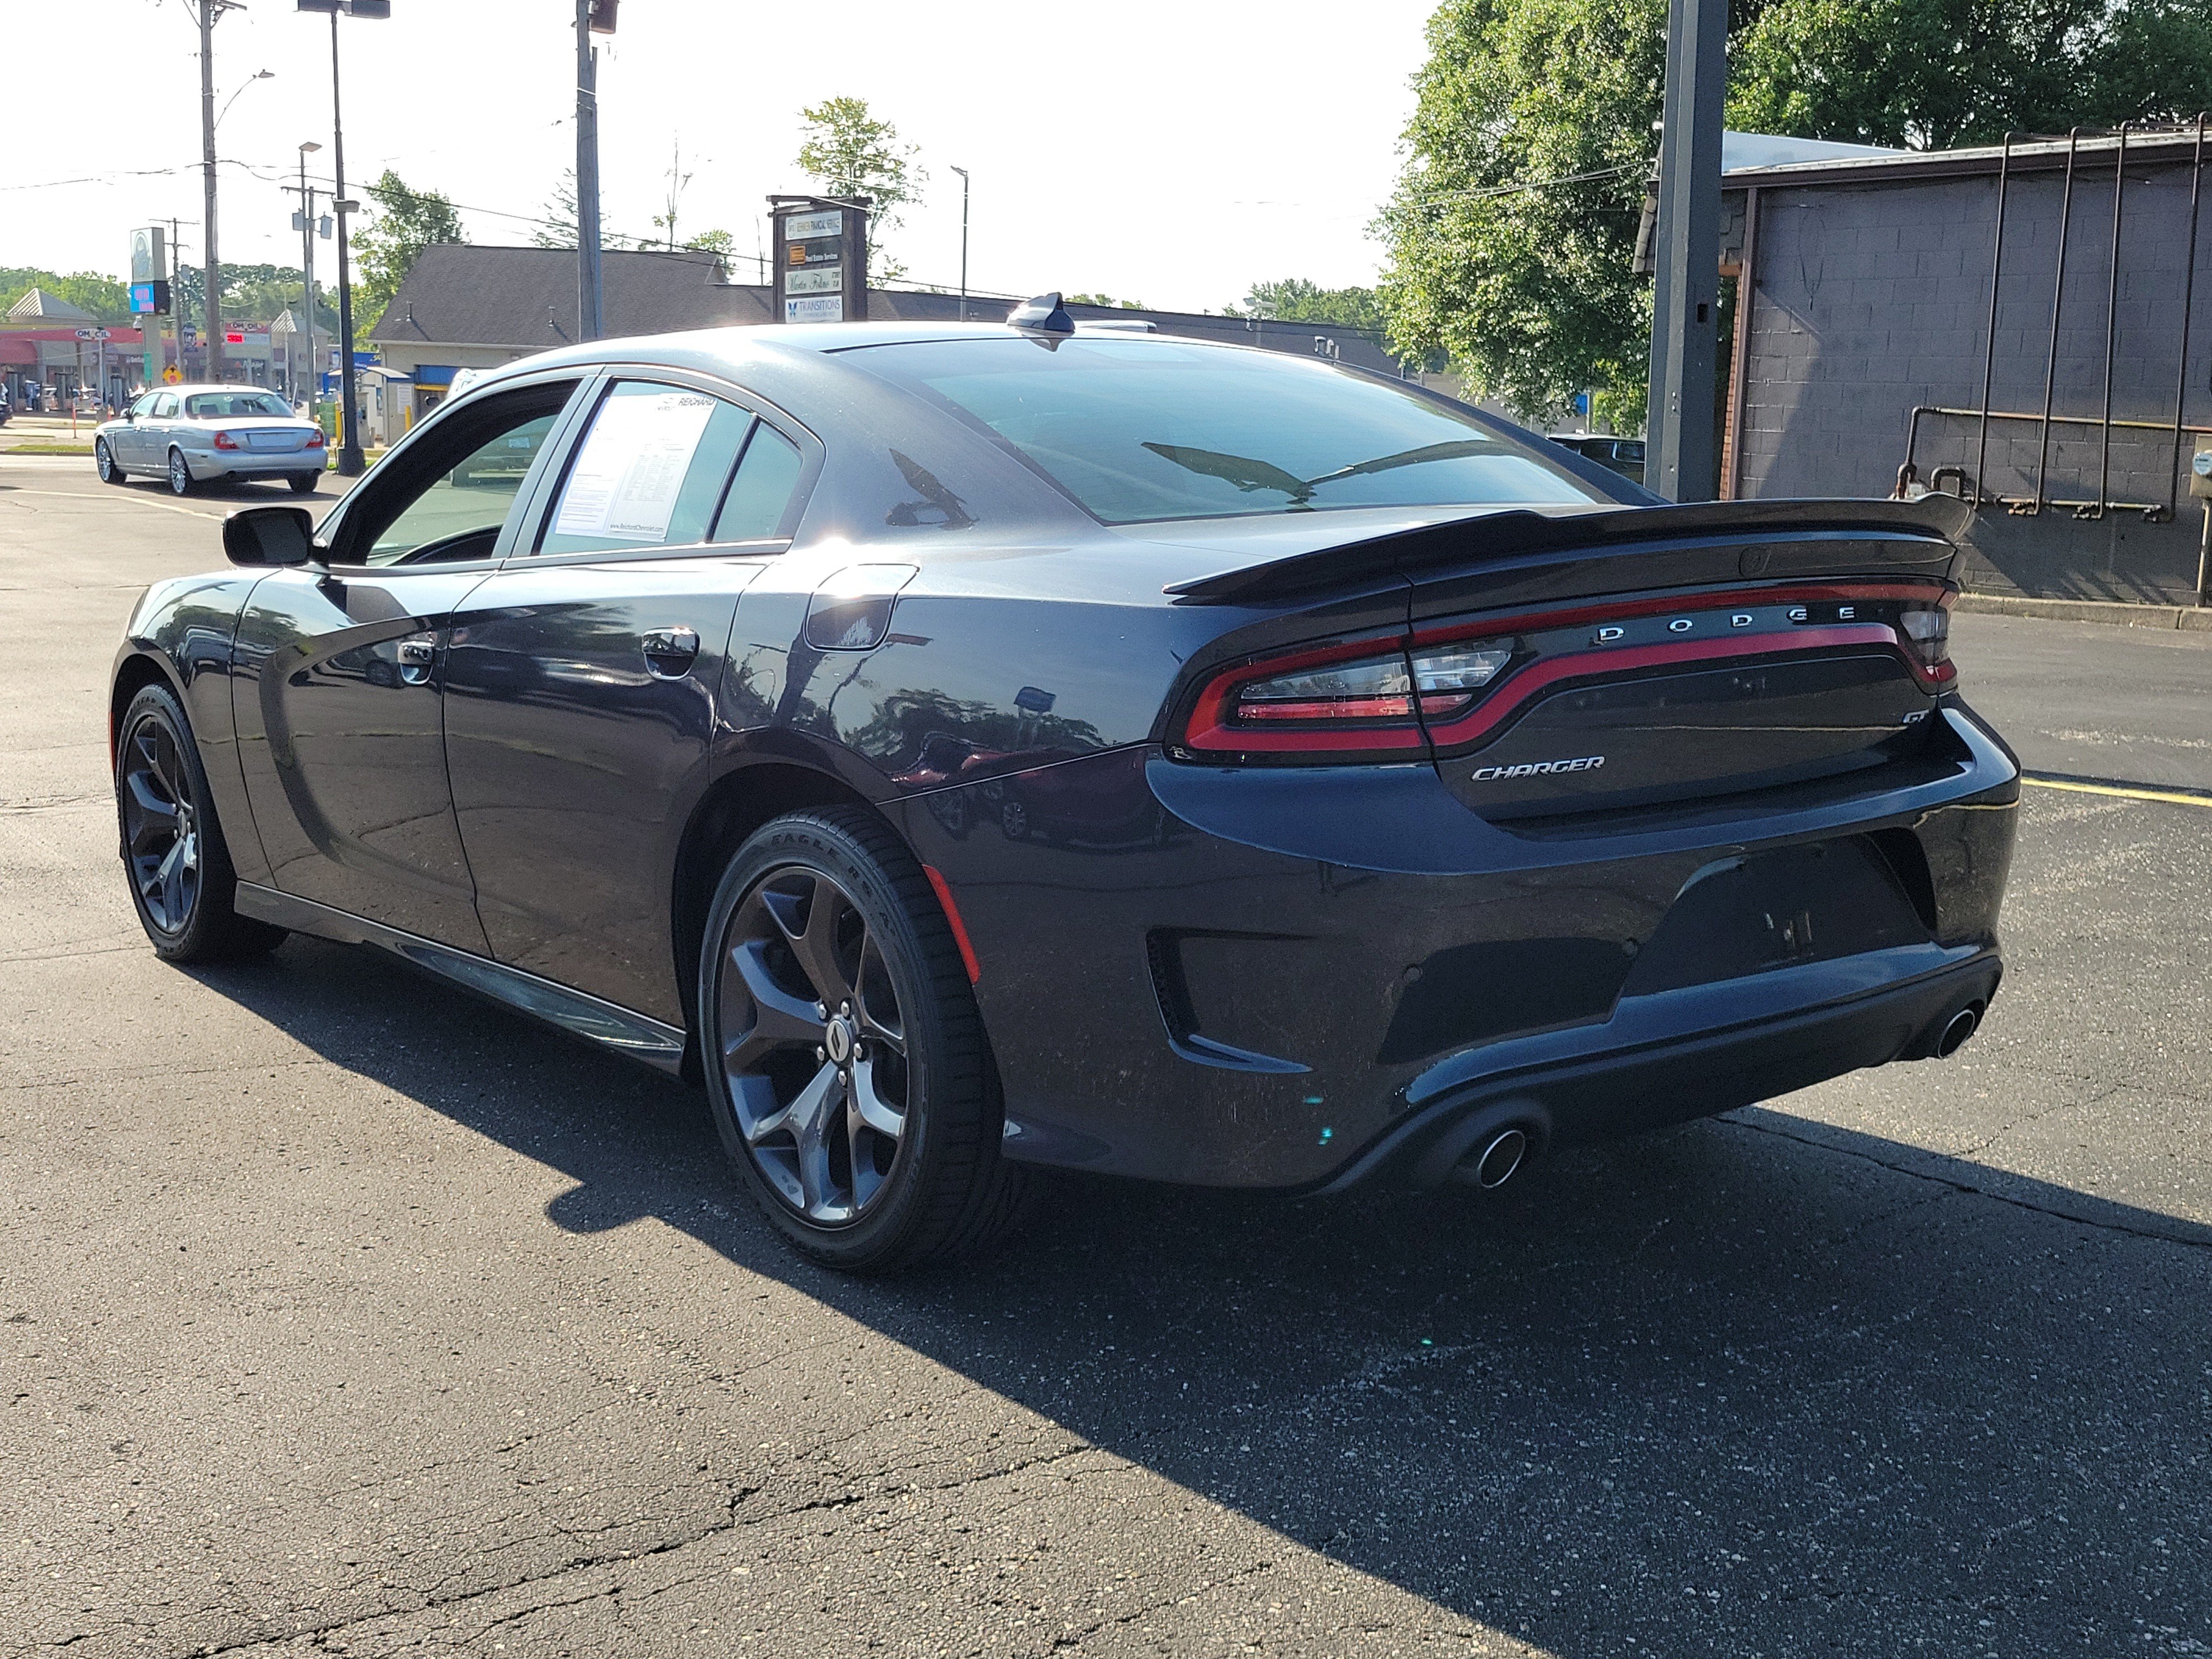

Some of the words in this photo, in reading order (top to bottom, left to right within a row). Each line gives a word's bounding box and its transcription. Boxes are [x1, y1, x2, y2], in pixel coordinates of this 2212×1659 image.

[799, 300, 840, 312] TRANSITIONS
[679, 396, 715, 407] REICHARD
[1598, 606, 1855, 641] DODGE
[1902, 709, 1930, 724] GT
[1471, 756, 1605, 781] CHARGER
[771, 833, 837, 861] EAGLE
